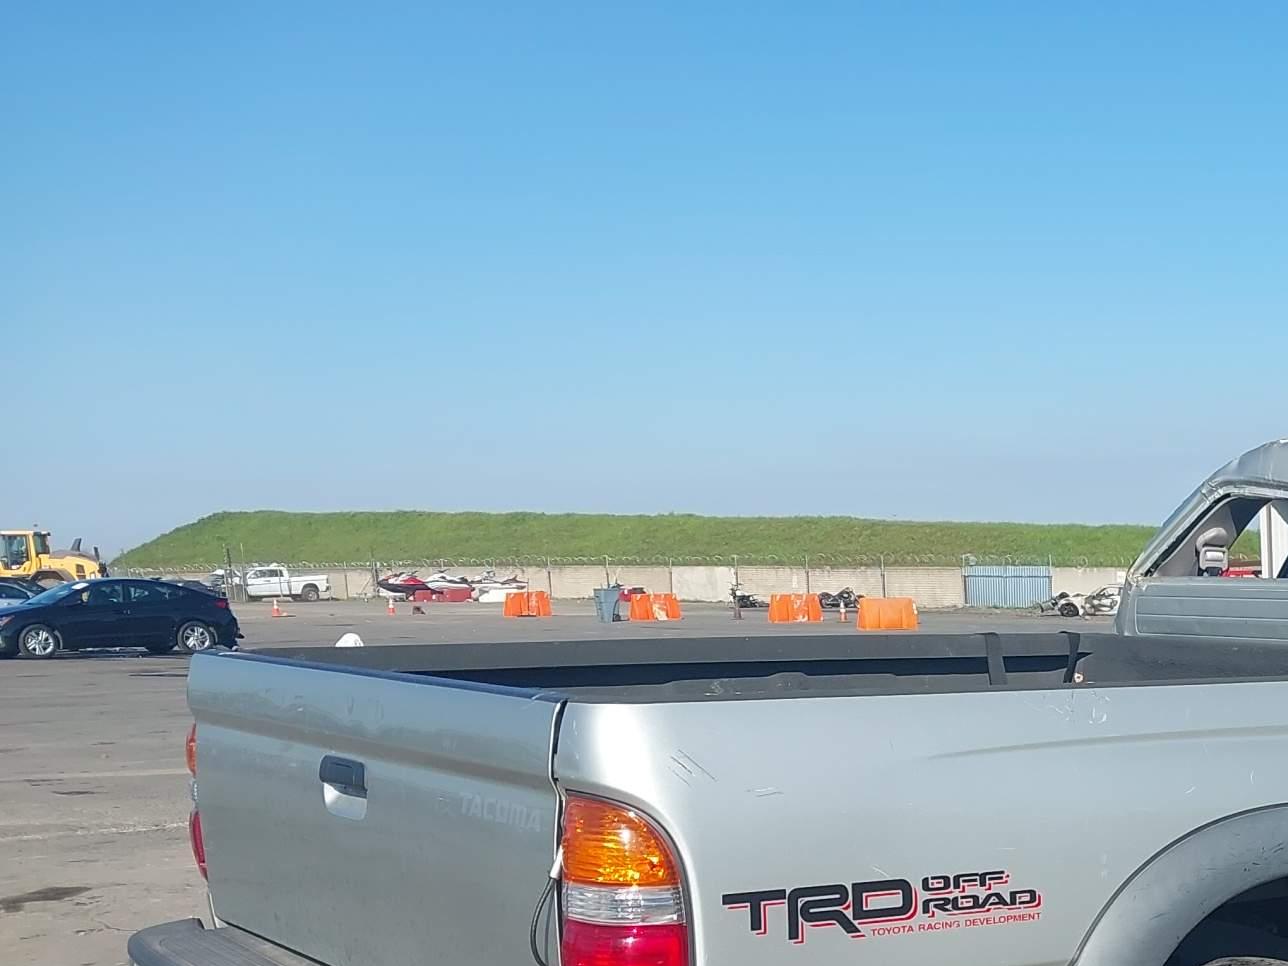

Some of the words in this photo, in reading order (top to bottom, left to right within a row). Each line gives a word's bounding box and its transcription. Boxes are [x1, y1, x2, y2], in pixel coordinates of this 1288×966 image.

[459, 791, 542, 833] TACOMA
[921, 870, 1010, 895] OFF
[721, 878, 918, 944] TRD
[921, 889, 1042, 918] ROAD
[870, 924, 915, 937] TOYOTA
[918, 920, 961, 933] RACING
[964, 912, 1041, 928] DEVELOPMENT
